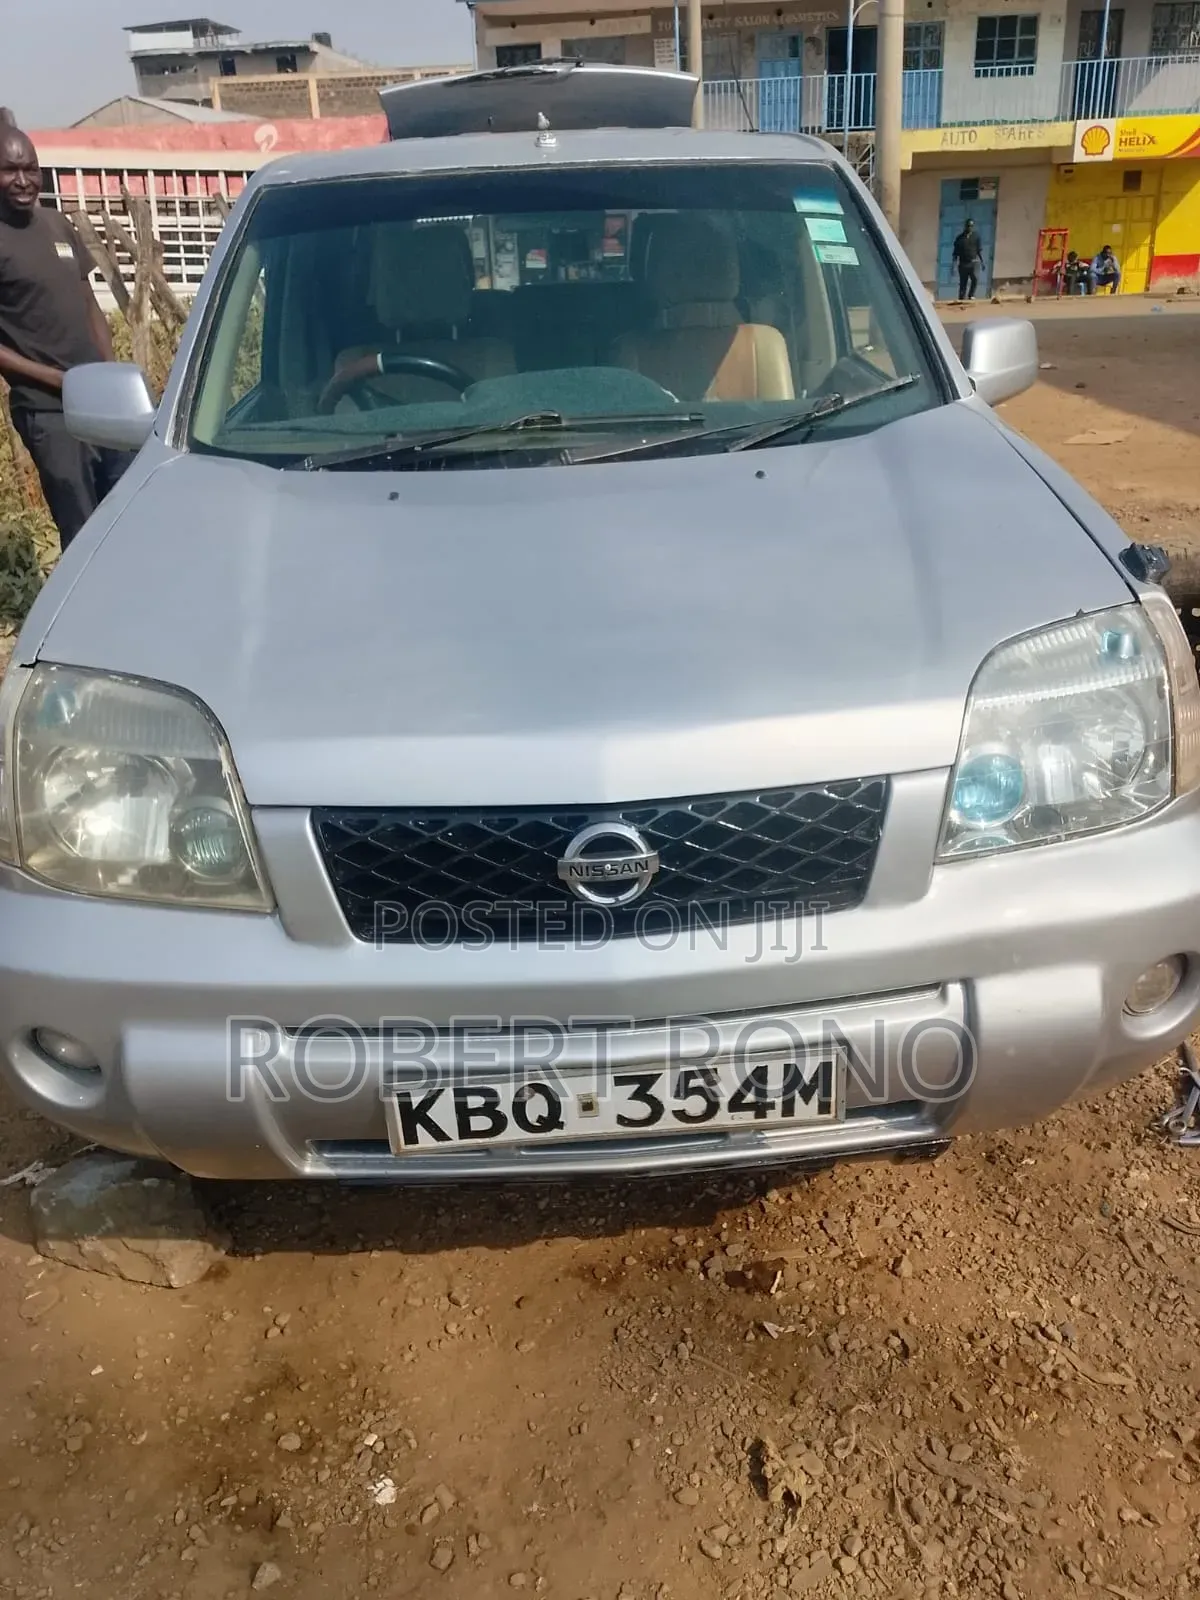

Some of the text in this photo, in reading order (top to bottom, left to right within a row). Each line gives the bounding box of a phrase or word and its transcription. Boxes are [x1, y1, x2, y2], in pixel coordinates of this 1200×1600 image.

[940, 130, 978, 146] AUTO
[1119, 135, 1156, 147] HELIX
[569, 860, 649, 877] NISSAN
[402, 1061, 833, 1145] KBQ 354M
